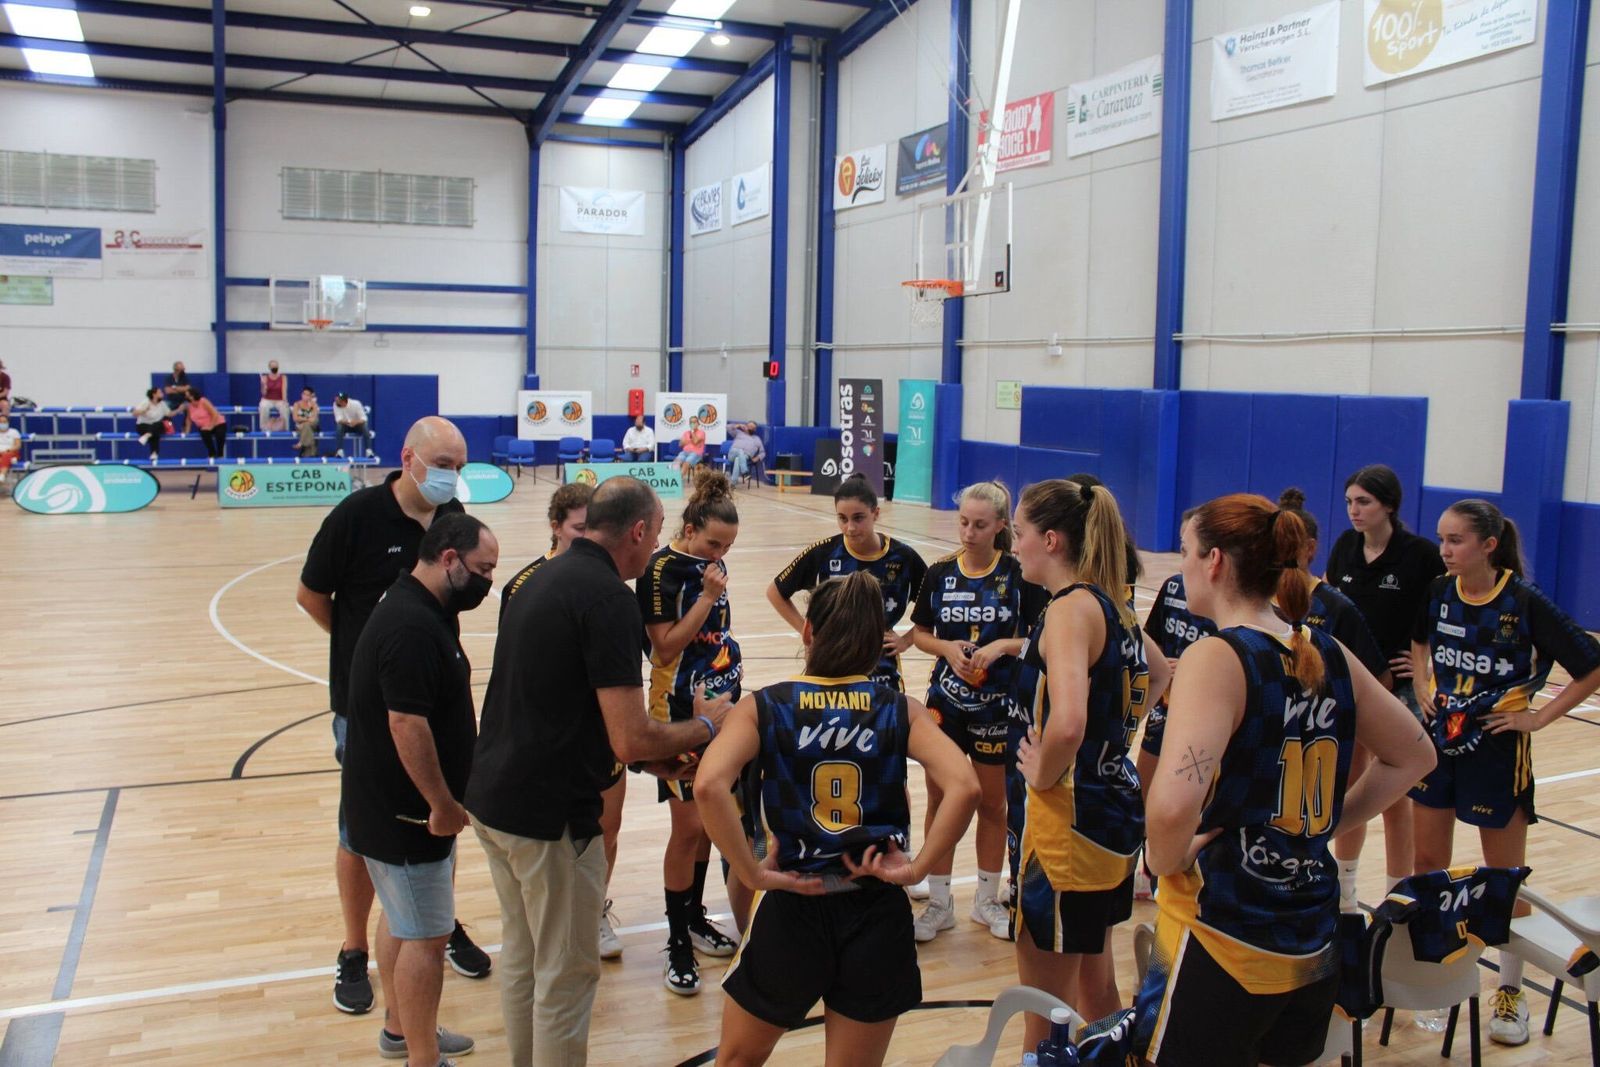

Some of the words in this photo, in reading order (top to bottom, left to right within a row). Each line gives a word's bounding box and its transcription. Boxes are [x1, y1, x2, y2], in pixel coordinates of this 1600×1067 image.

[1387, 21, 1438, 60] sport
[1091, 73, 1149, 100] CARPINTERIA
[1096, 92, 1144, 119] Caravaca
[577, 207, 628, 217] PARADOR
[24, 232, 65, 247] pelayo
[769, 361, 779, 377] 0
[291, 469, 321, 480] CAB
[629, 467, 656, 477] CAB
[266, 481, 347, 492] ESTEPONA
[1452, 673, 1475, 696] 14
[799, 691, 871, 711] MOYANO
[1264, 736, 1339, 838] 10
[811, 760, 863, 835] 8
